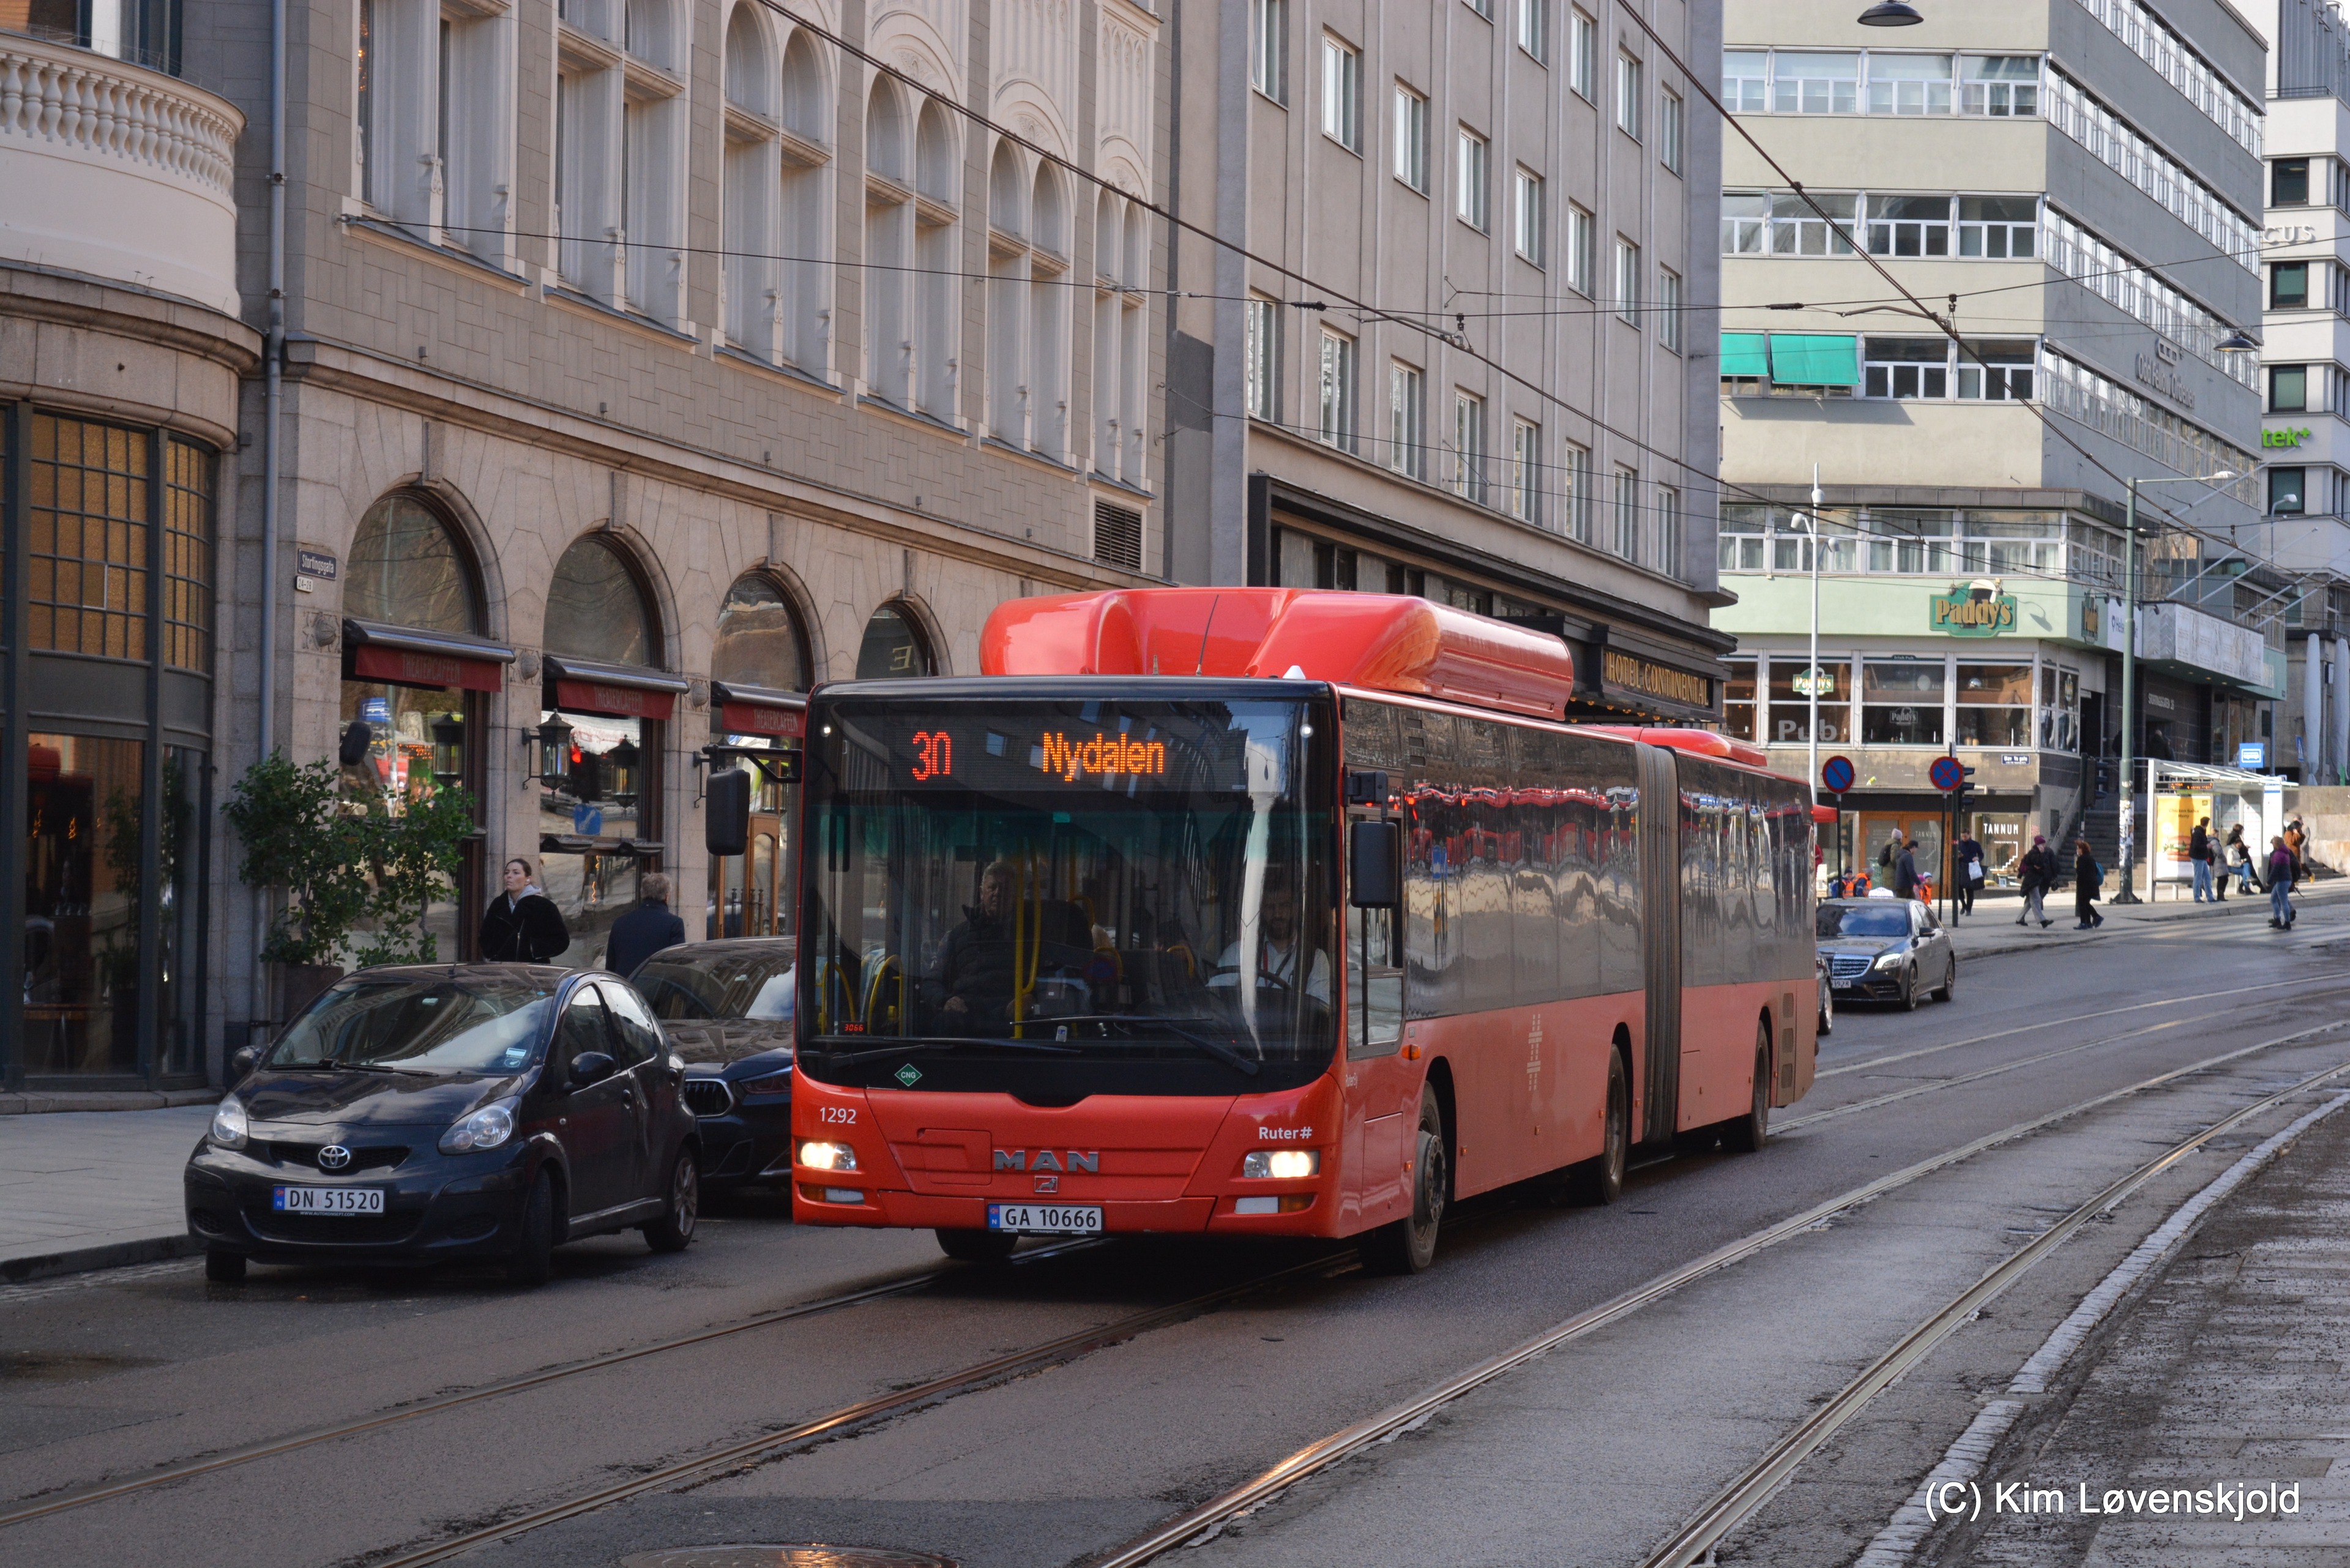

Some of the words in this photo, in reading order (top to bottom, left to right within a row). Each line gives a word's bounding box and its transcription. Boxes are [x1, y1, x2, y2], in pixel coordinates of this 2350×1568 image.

[302, 554, 334, 575] Stortingsgata
[298, 578, 312, 591] 24-28
[1936, 599, 2011, 629] Paddy's
[1606, 651, 1641, 689] HOTEL
[1644, 663, 1709, 706] CONTINENTAL
[753, 709, 798, 733] THEATERCAFEEN
[1892, 712, 1917, 722] Paddy's
[1778, 719, 1837, 742] Pub
[912, 731, 952, 781] 30
[1043, 733, 1164, 782] Nydalen
[1983, 823, 2018, 835] TANNUM
[820, 1107, 857, 1124] 1292
[1259, 1126, 1312, 1140] Ruter#
[994, 1149, 1099, 1172] MAN
[289, 1190, 313, 1208] DN
[324, 1191, 380, 1210] 51520
[1005, 1208, 1031, 1226] GA
[1039, 1208, 1097, 1228] 10666
